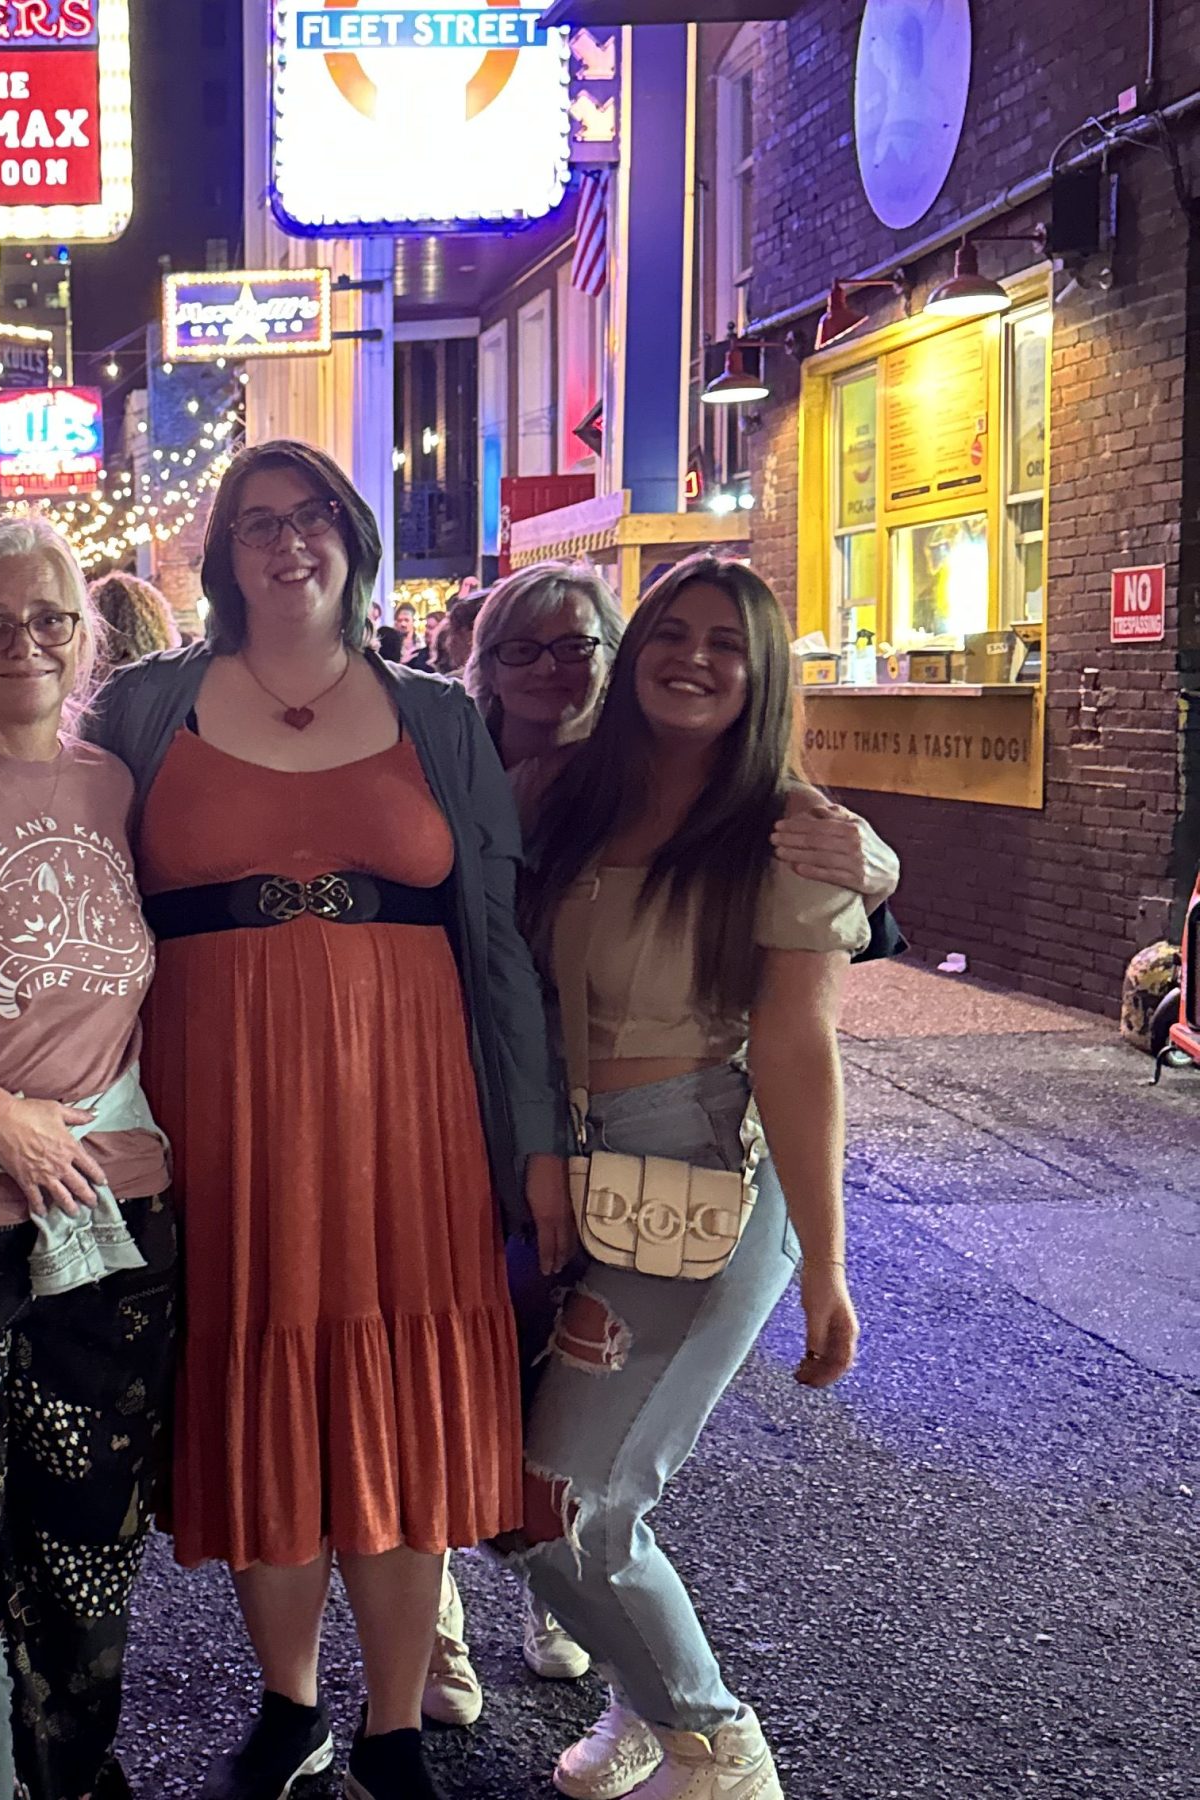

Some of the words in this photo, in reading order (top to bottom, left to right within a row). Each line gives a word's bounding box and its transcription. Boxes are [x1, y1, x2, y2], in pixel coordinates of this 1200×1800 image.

[302, 14, 404, 46] FLEET
[412, 13, 541, 46] STREET
[1124, 573, 1152, 612] NO
[1114, 614, 1161, 635] TRESPASSING
[805, 728, 847, 751] GOLLY
[854, 731, 900, 754] THAT'S
[908, 733, 919, 755] A
[924, 734, 972, 758] TASTY
[15, 816, 57, 840] AND
[18, 970, 74, 1000] VIBE
[82, 977, 129, 997] LIKE
